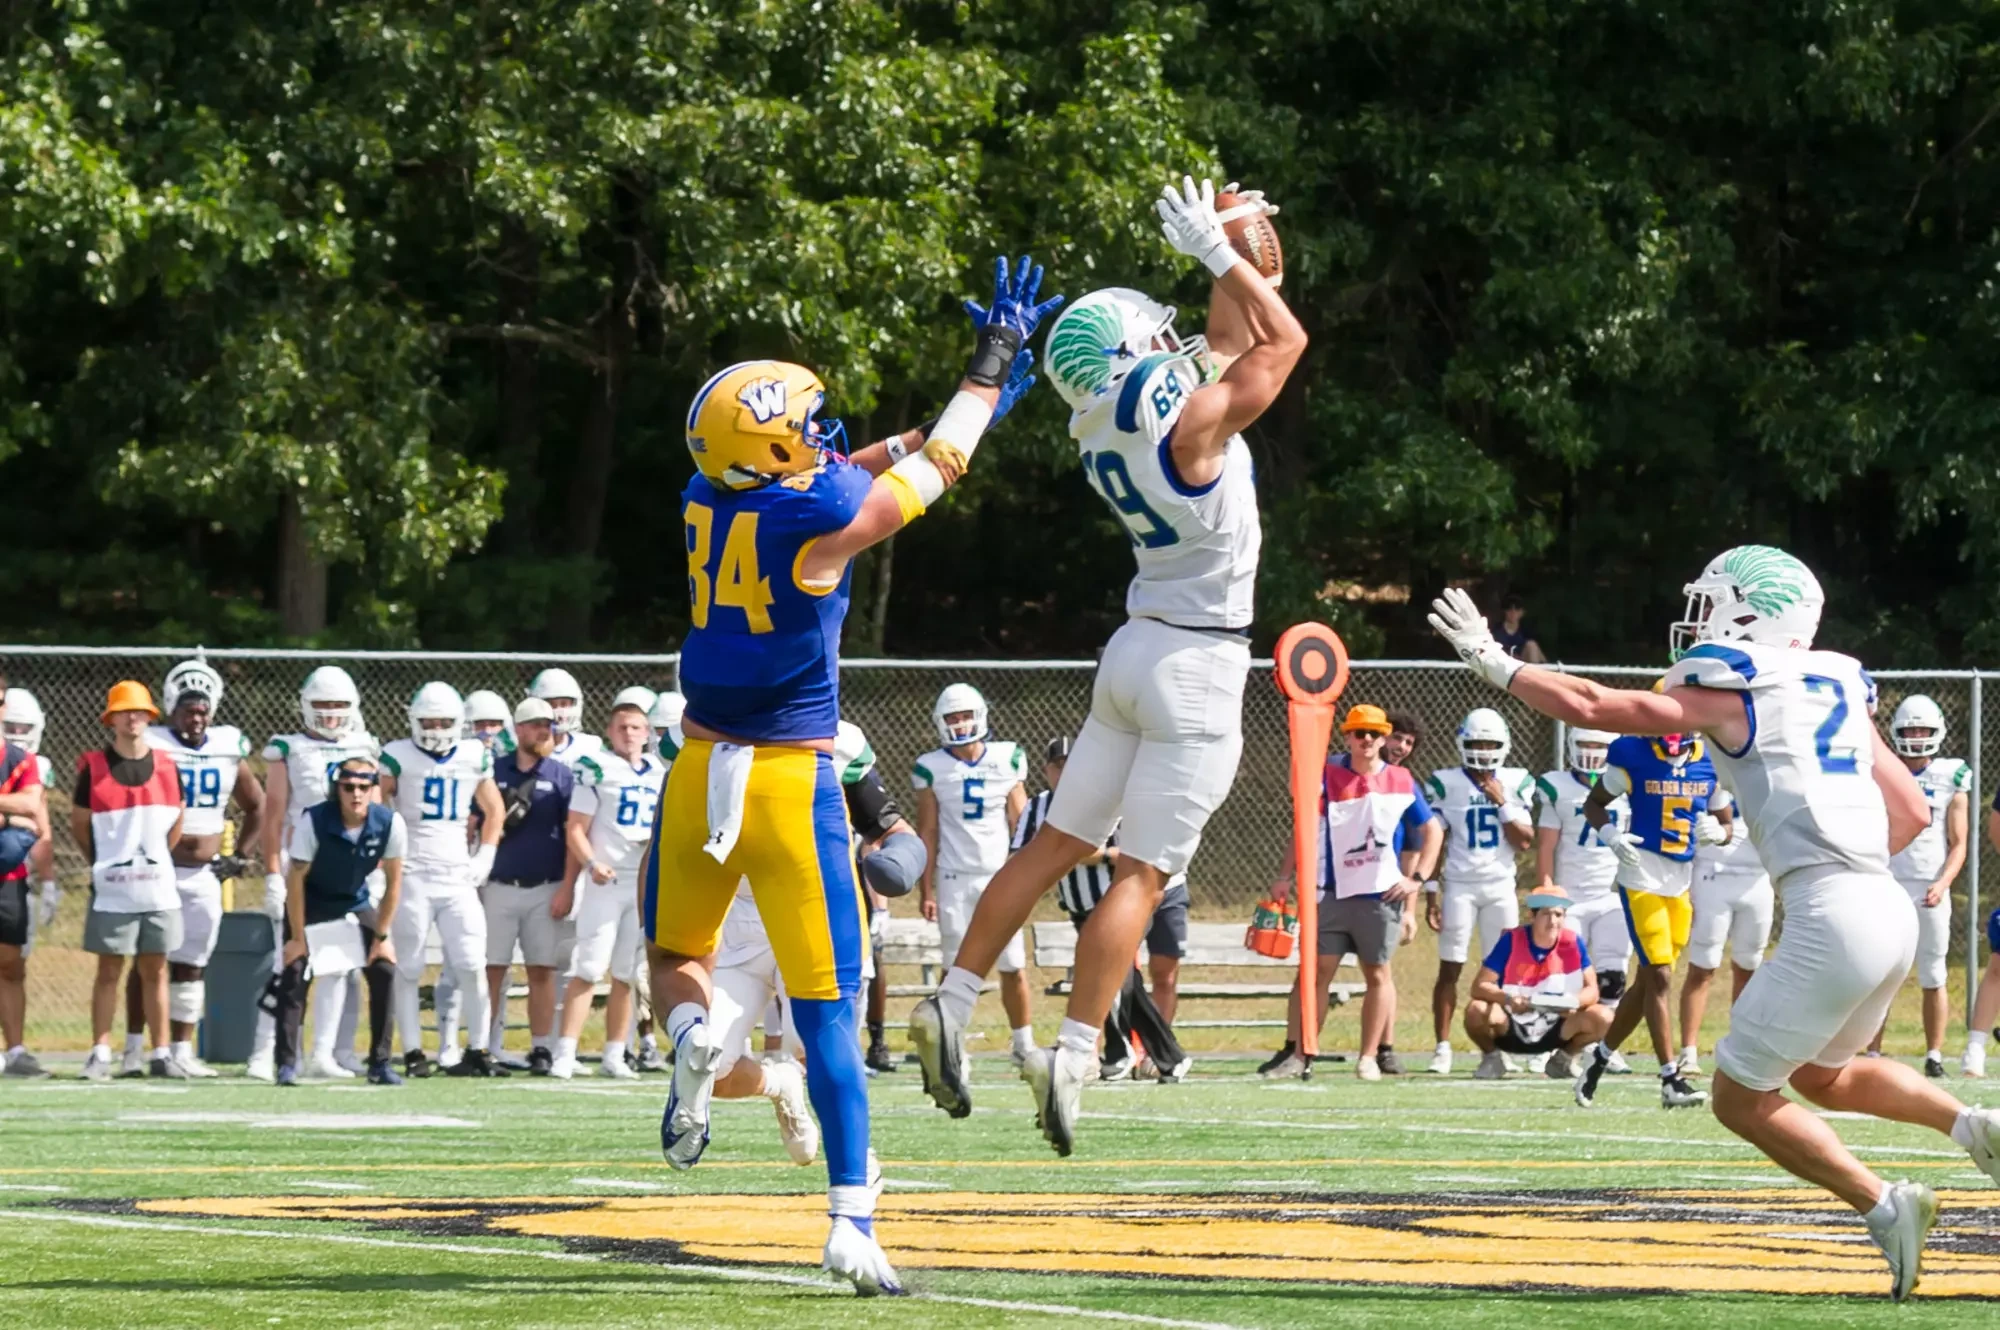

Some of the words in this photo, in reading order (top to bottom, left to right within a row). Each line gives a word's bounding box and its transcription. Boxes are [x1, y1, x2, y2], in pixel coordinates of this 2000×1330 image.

[742, 377, 786, 424] W
[1080, 450, 1180, 549] 9
[684, 500, 775, 634] 84
[1800, 673, 1859, 775] 2
[421, 777, 459, 820] 91
[962, 777, 985, 820] 5
[1465, 807, 1499, 849] 15
[1660, 796, 1693, 855] 5
